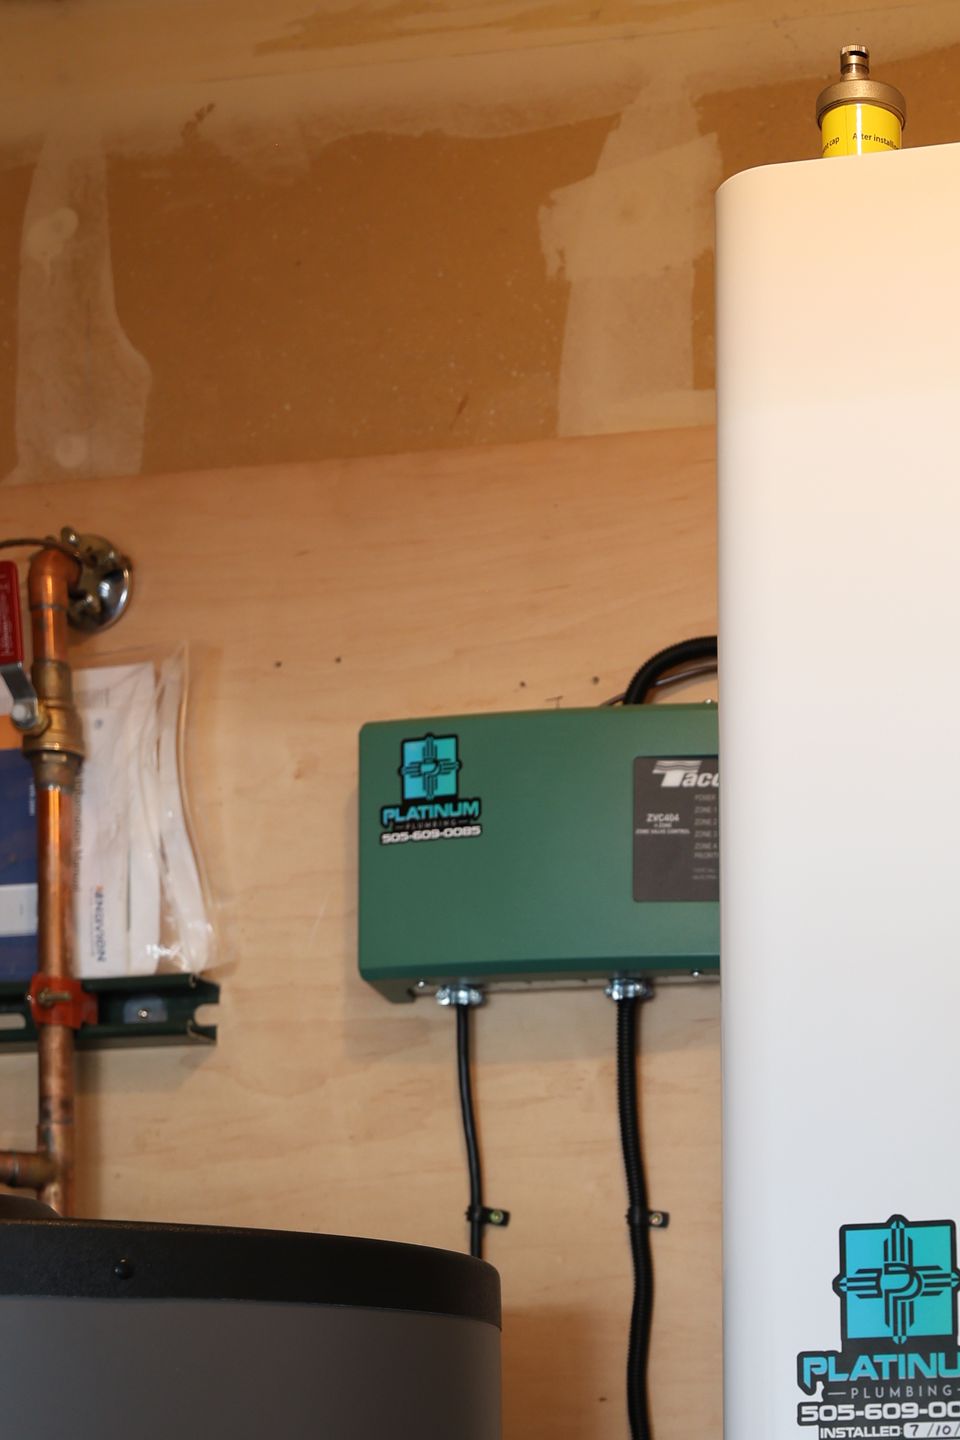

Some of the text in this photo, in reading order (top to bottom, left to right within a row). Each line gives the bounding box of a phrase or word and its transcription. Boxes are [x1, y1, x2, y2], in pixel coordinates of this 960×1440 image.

[852, 132, 872, 142] Ater
[383, 800, 480, 827] PLATINUM
[851, 1384, 953, 1399] PLUMBING
[820, 1425, 903, 1439] INSTALLED:
